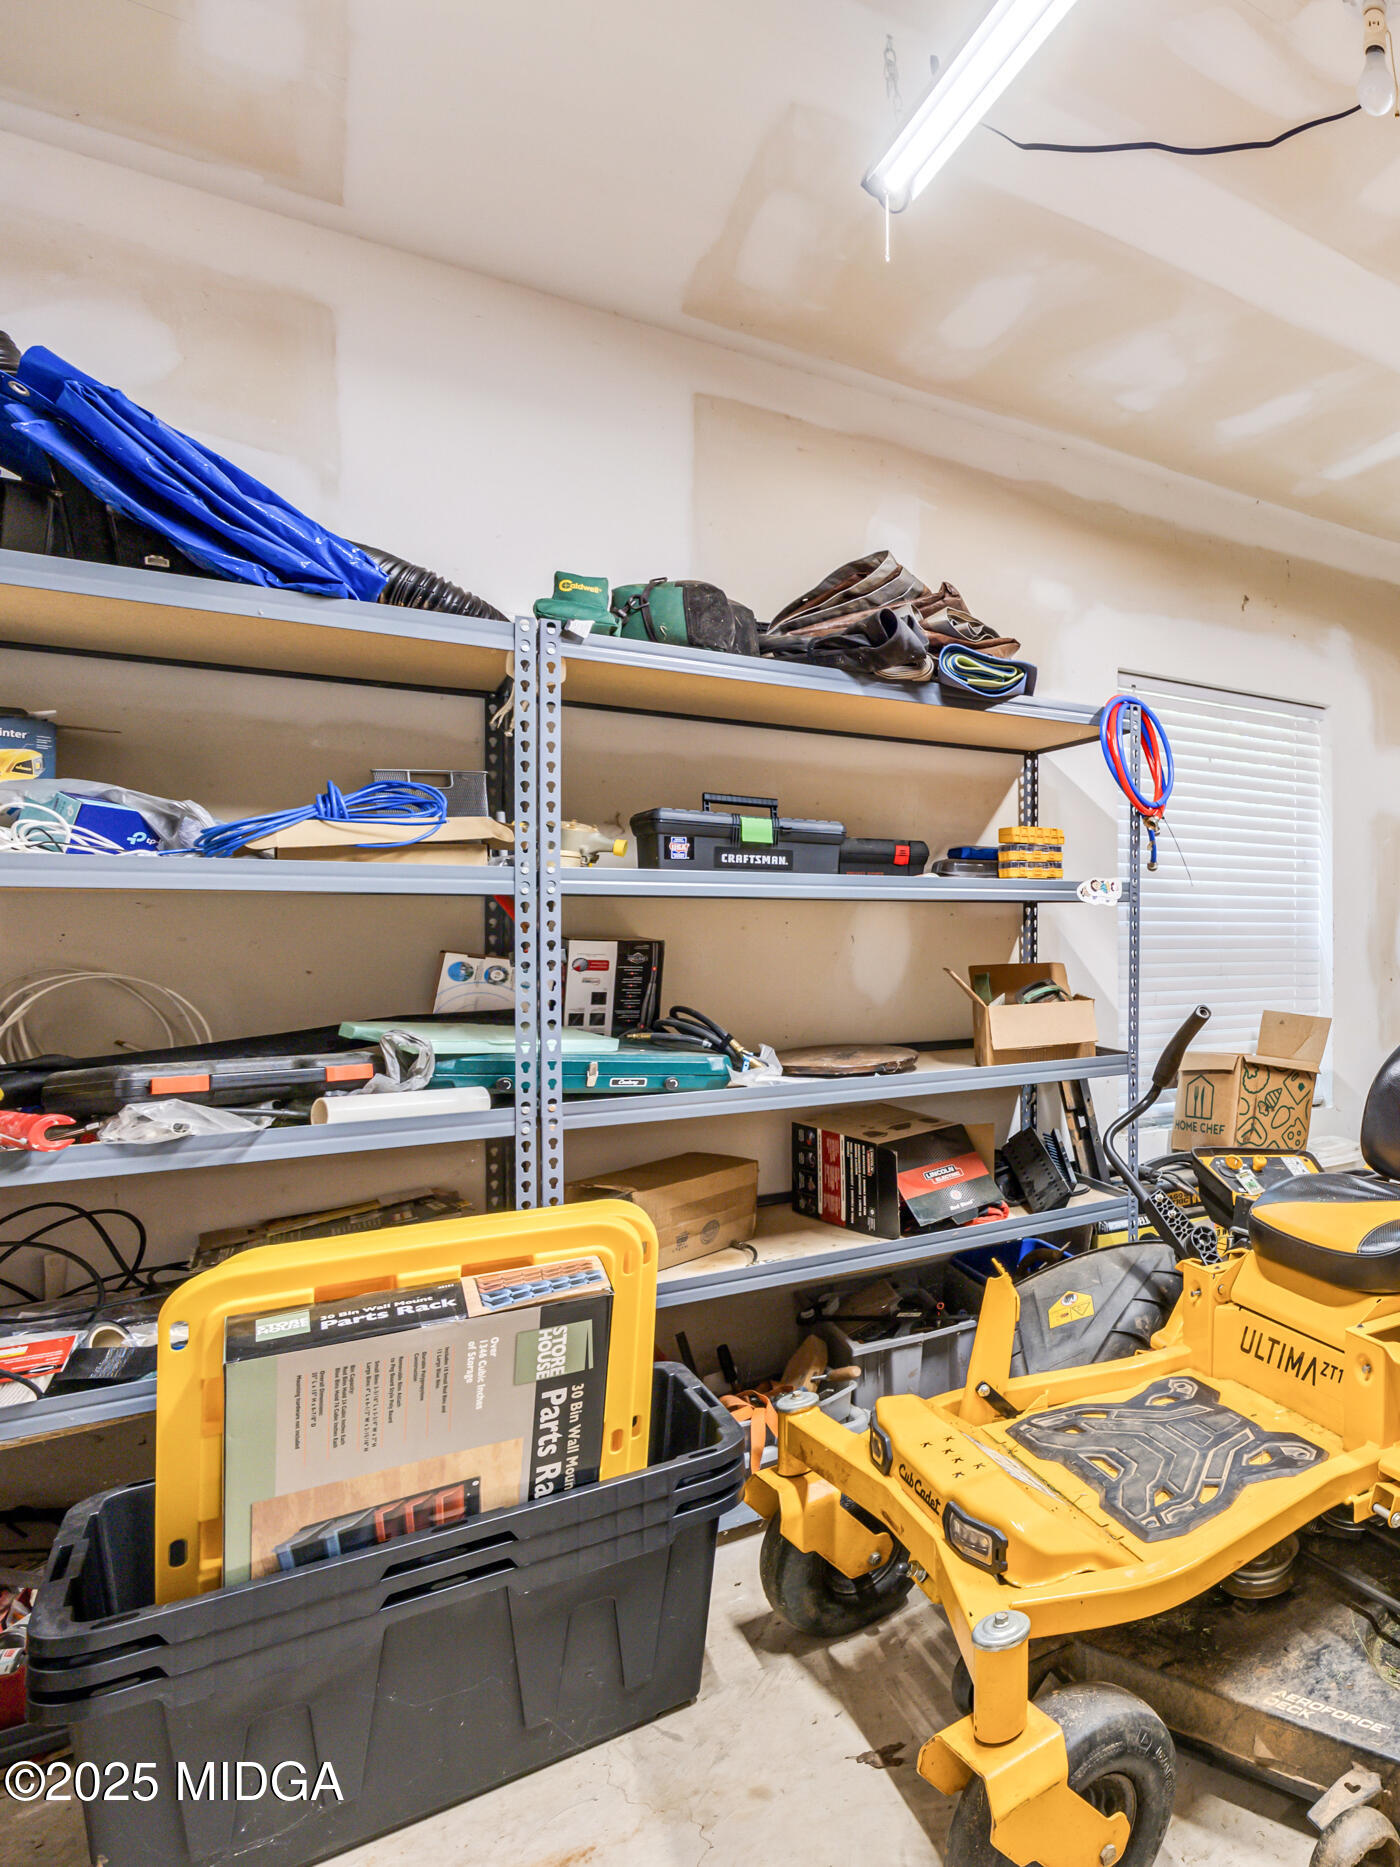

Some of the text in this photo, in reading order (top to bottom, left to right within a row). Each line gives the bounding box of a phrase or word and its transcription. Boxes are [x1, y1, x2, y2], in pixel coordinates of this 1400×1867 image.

[721, 853, 788, 865] CRAFTSMAN
[1175, 1120, 1226, 1135] HOME CHEF
[925, 1165, 957, 1180] LINCOLN
[320, 1296, 434, 1322] 30 Bin Wall Mount
[320, 1297, 458, 1331] Parts Rack
[464, 1341, 476, 1384] of Storage
[490, 1337, 500, 1357] Over
[536, 1328, 552, 1380] HOUSE
[550, 1326, 567, 1377] STORE
[1240, 1325, 1344, 1386] ULTIMA ZT1
[475, 1340, 488, 1409] 1346 Cubic Inches
[534, 1387, 568, 1498] Parts Ra
[564, 1383, 584, 1490] 30 Bin Wall Moun
[899, 1464, 942, 1515] Cub Cadet
[1263, 1697, 1315, 1720] DECK
[1271, 1689, 1391, 1733] AEROFORCE
